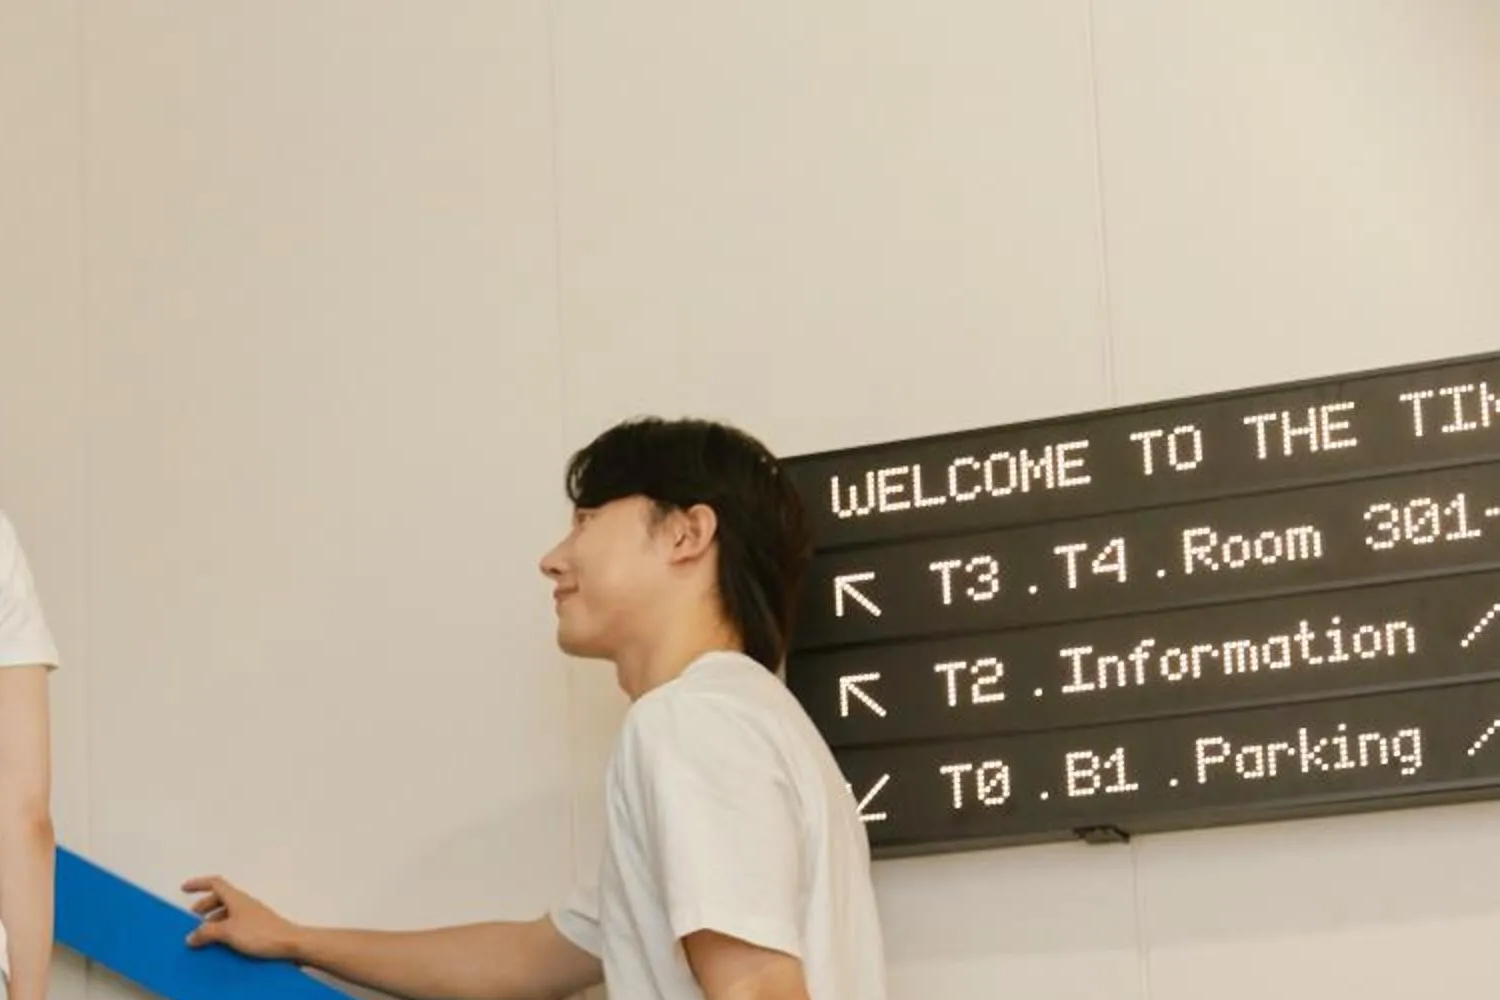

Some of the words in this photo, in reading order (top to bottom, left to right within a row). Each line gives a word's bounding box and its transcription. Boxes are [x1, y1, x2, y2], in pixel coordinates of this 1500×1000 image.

[831, 440, 1091, 519] WELCOME
[1130, 425, 1203, 475] TO
[1243, 401, 1358, 459] THE
